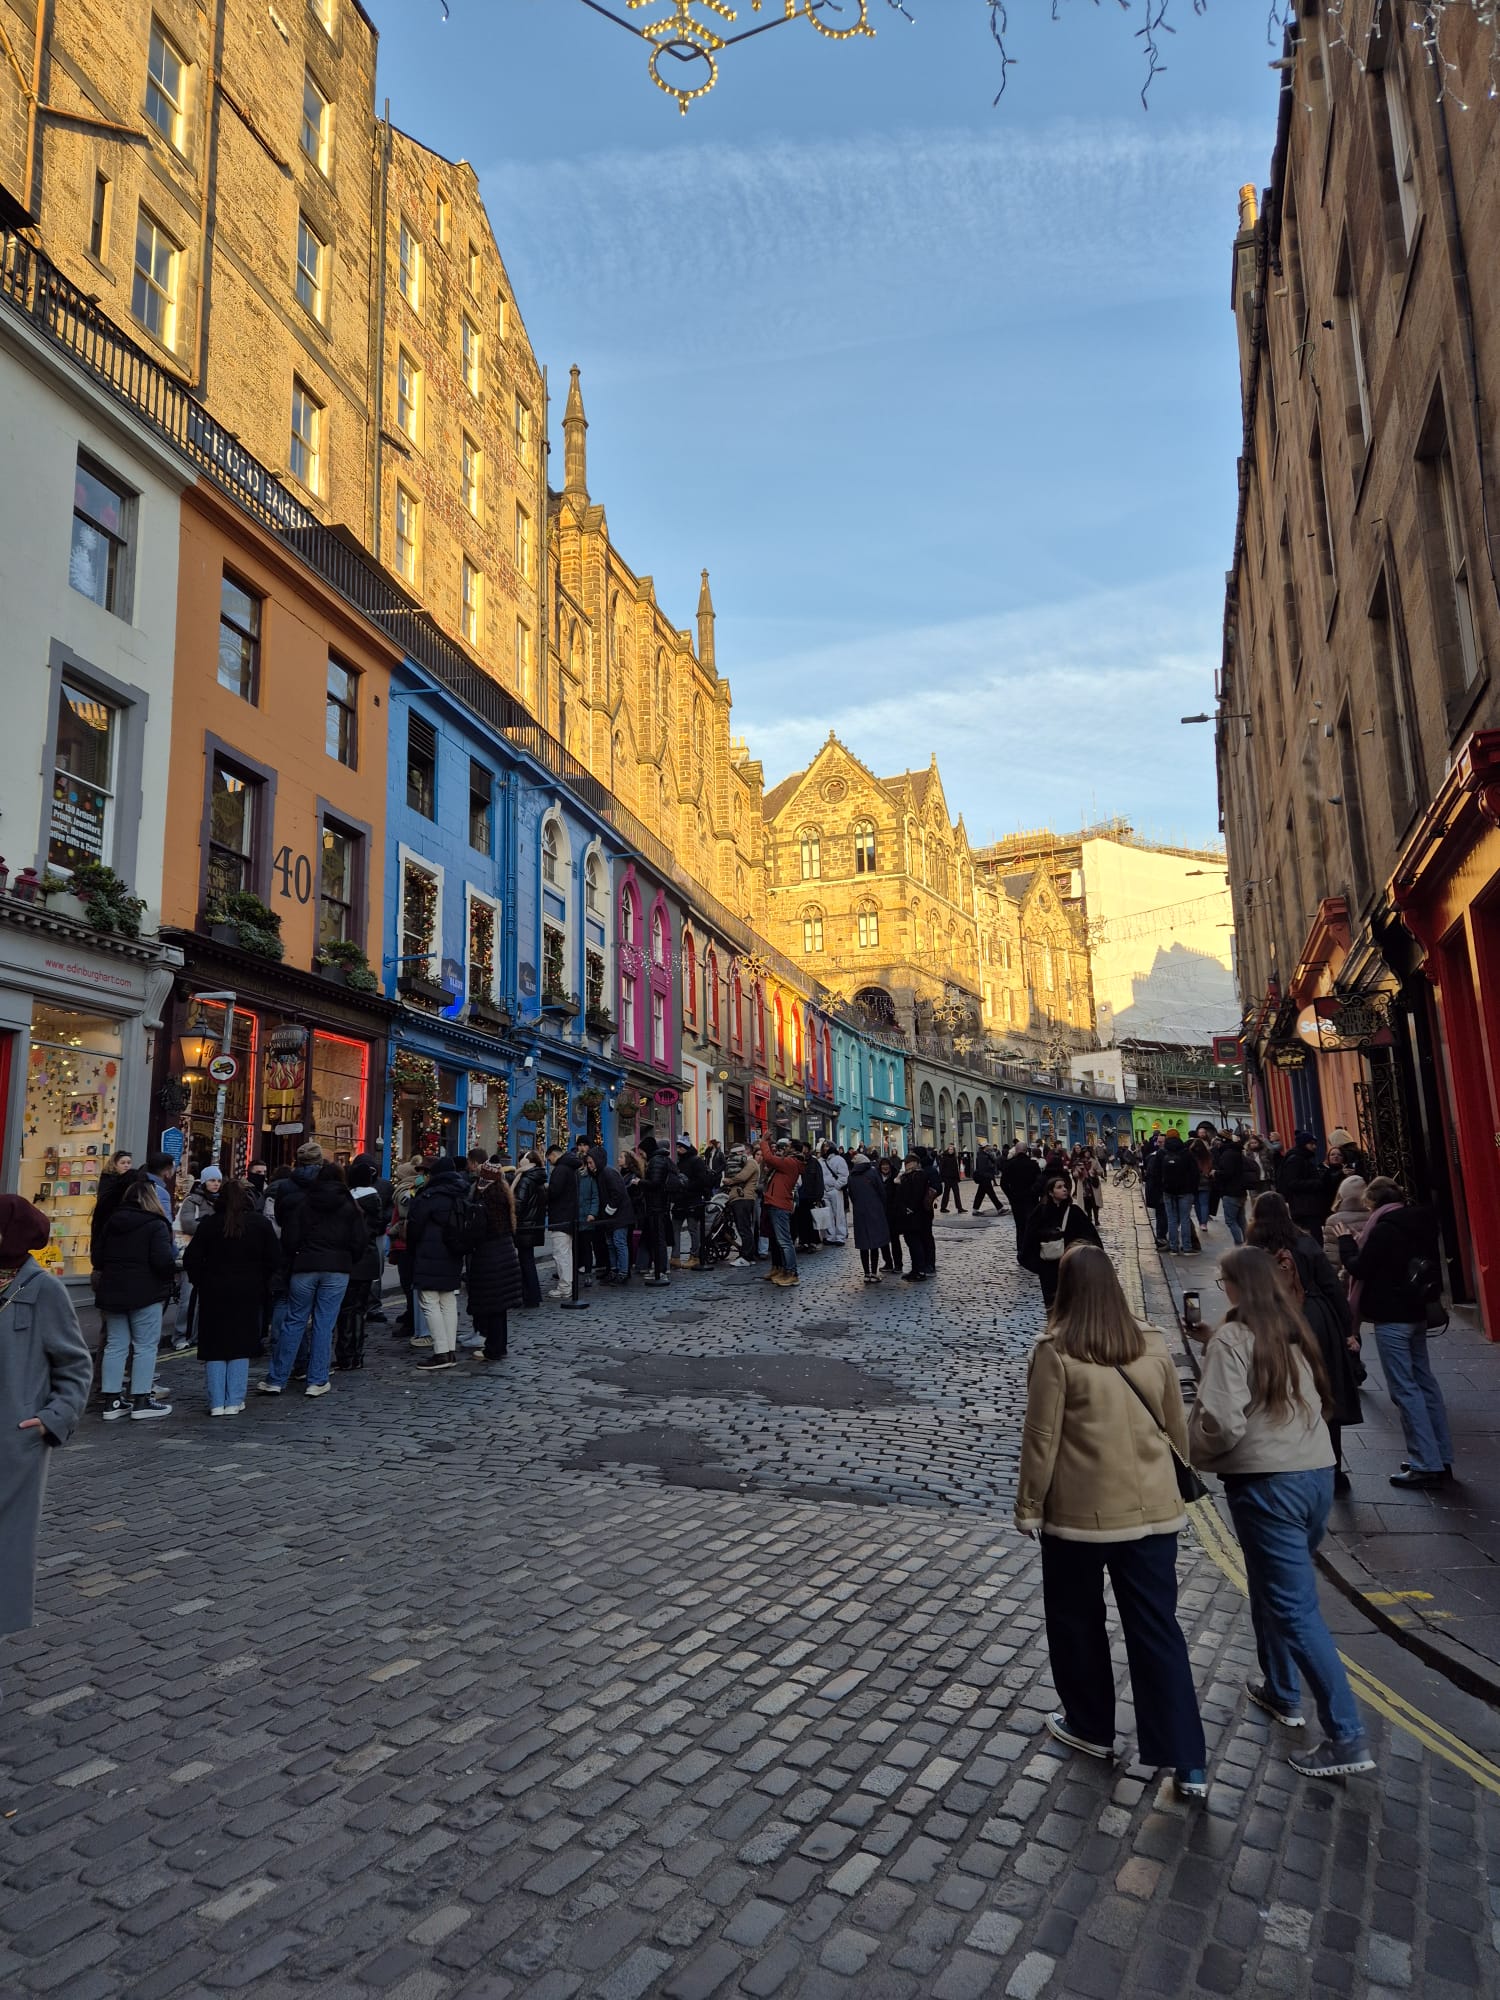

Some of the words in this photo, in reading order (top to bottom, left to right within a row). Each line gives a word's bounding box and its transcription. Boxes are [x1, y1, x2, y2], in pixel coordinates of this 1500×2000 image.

[273, 846, 311, 904] 40
[45, 959, 132, 987] www.edinburghart.com
[203, 1045, 215, 1058] 40
[192, 1077, 242, 1105] MUSUM
[319, 1099, 360, 1125] MUSEUM
